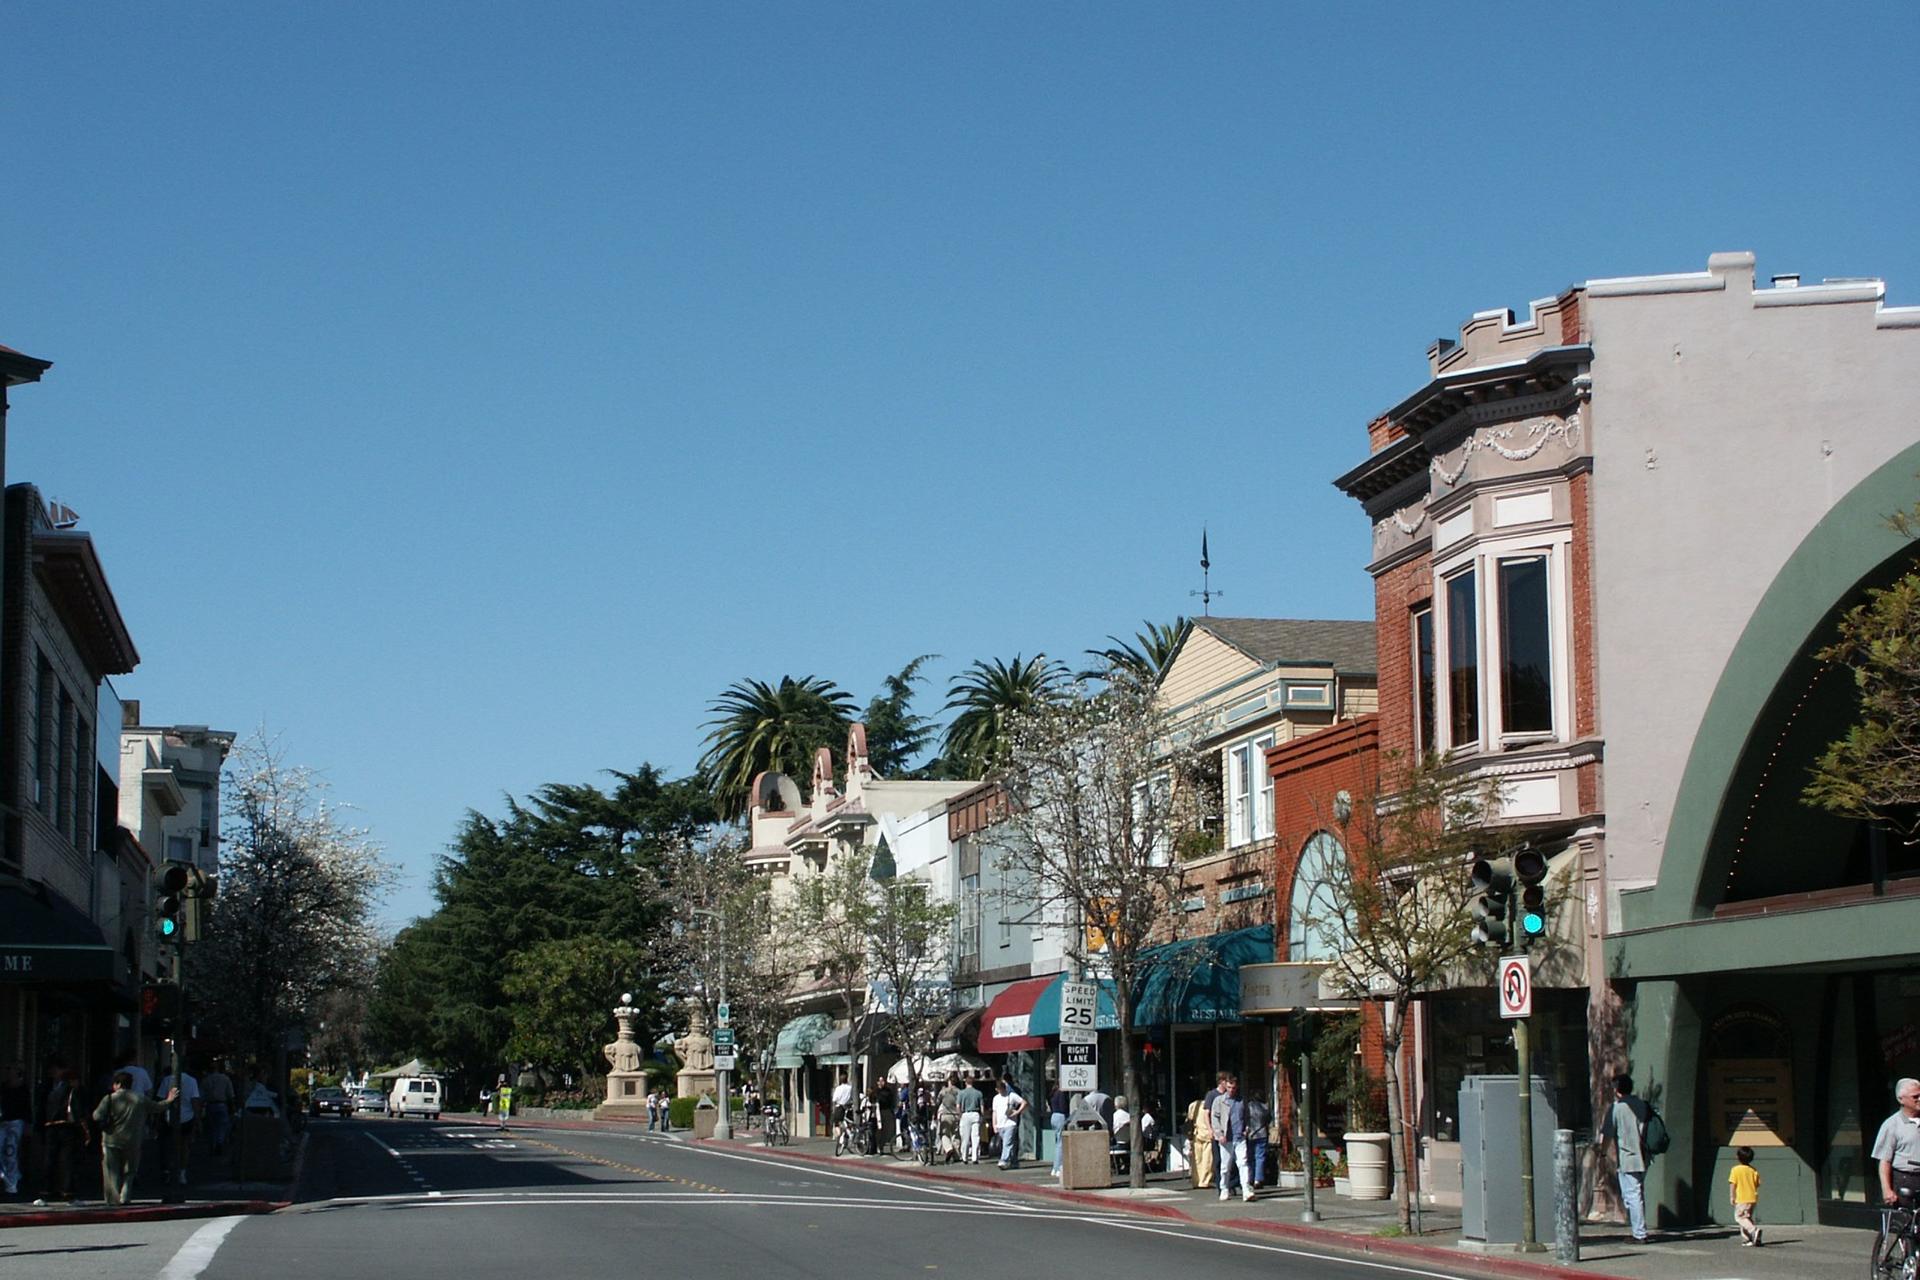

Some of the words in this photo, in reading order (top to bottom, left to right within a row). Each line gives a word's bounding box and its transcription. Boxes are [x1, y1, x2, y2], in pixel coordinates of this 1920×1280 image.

[1065, 985, 1096, 996] SPEED
[1066, 996, 1093, 1006] LIMIT
[1064, 1007, 1092, 1025] 25
[1067, 1045, 1090, 1055] RIGHT
[1068, 1054, 1089, 1063] LANE
[1067, 1078, 1088, 1087] ONLY
